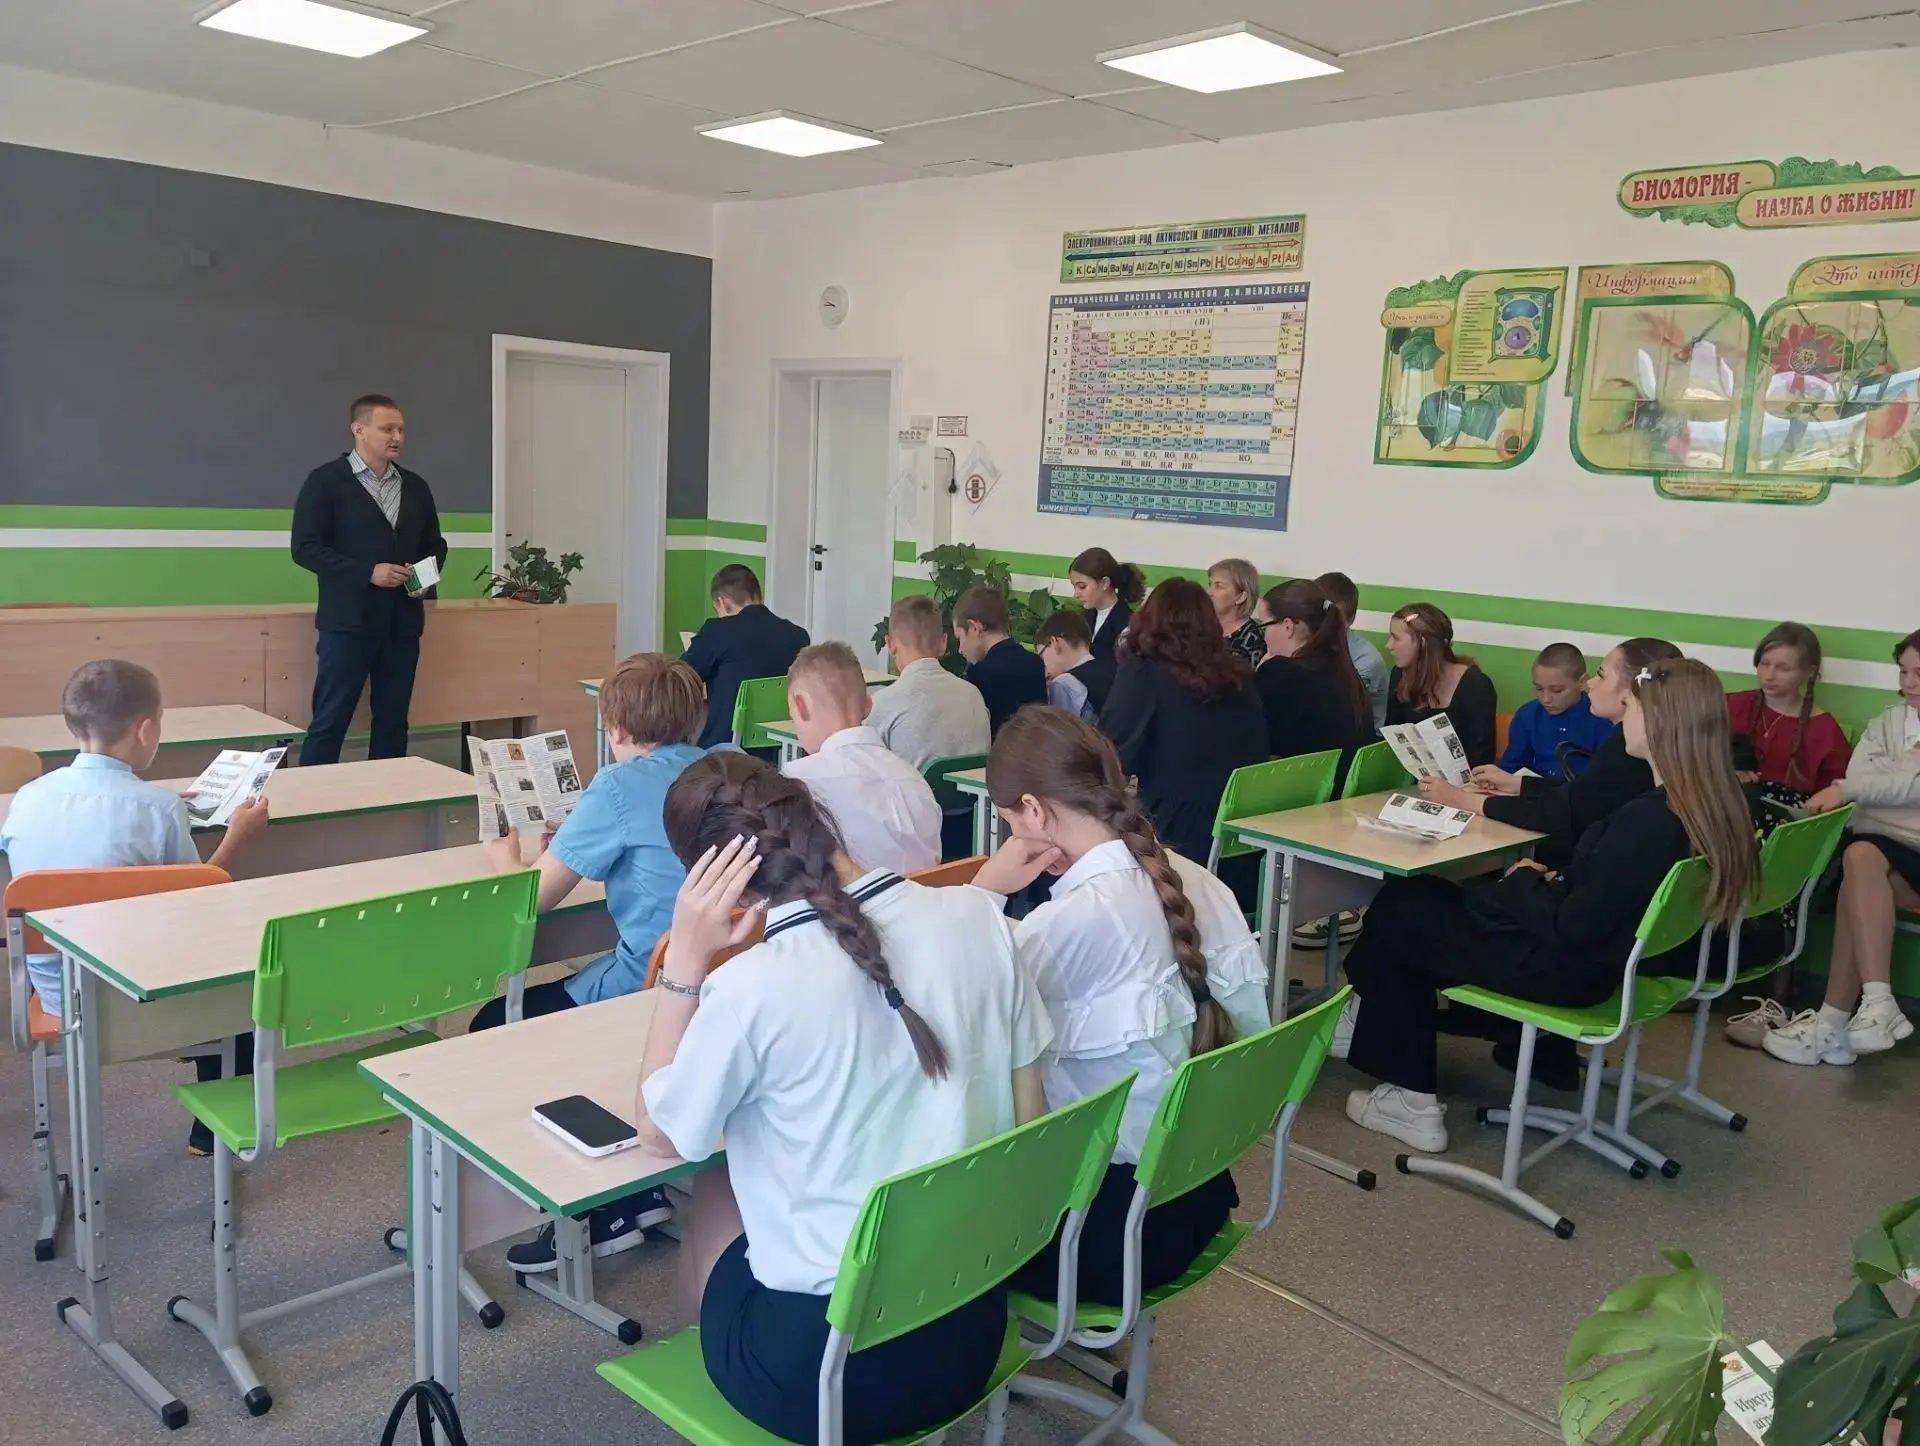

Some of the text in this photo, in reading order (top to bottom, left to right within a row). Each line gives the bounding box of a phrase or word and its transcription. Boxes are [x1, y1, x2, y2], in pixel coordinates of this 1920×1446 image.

[1631, 172, 1740, 202] БИОЛОГИЯ
[1755, 188, 1916, 218] НАУКА О ЖИЗНИ!
[1139, 234, 1152, 246] РЯД
[1258, 221, 1300, 235] МЕТАЛЛОВ
[1076, 266, 1082, 274] K
[1086, 265, 1096, 274] Ca
[1098, 265, 1108, 273] Na
[1110, 264, 1120, 272] Ba
[1122, 264, 1133, 273] Mg
[1136, 262, 1145, 271] Al
[1147, 262, 1158, 270] Zn
[1160, 261, 1170, 269] Fe
[1174, 260, 1183, 268] Ni
[1186, 259, 1197, 268] Sn
[1200, 259, 1211, 267] Pb
[1228, 257, 1239, 265] Cu
[1242, 257, 1253, 266] Hg
[1256, 256, 1268, 265] Ag
[1272, 254, 1281, 263] Pt
[1285, 253, 1298, 262] Au
[1812, 264, 1858, 286] Это
[1587, 270, 1697, 295] Информация
[1054, 294, 1119, 305] ПЕРИОДИЧЕСКАЯ
[1125, 292, 1161, 302] СИСТЕМА
[1167, 288, 1218, 300] ЭЛЕМЕНТОВ
[1040, 504, 1064, 512] ХИМИЯ
